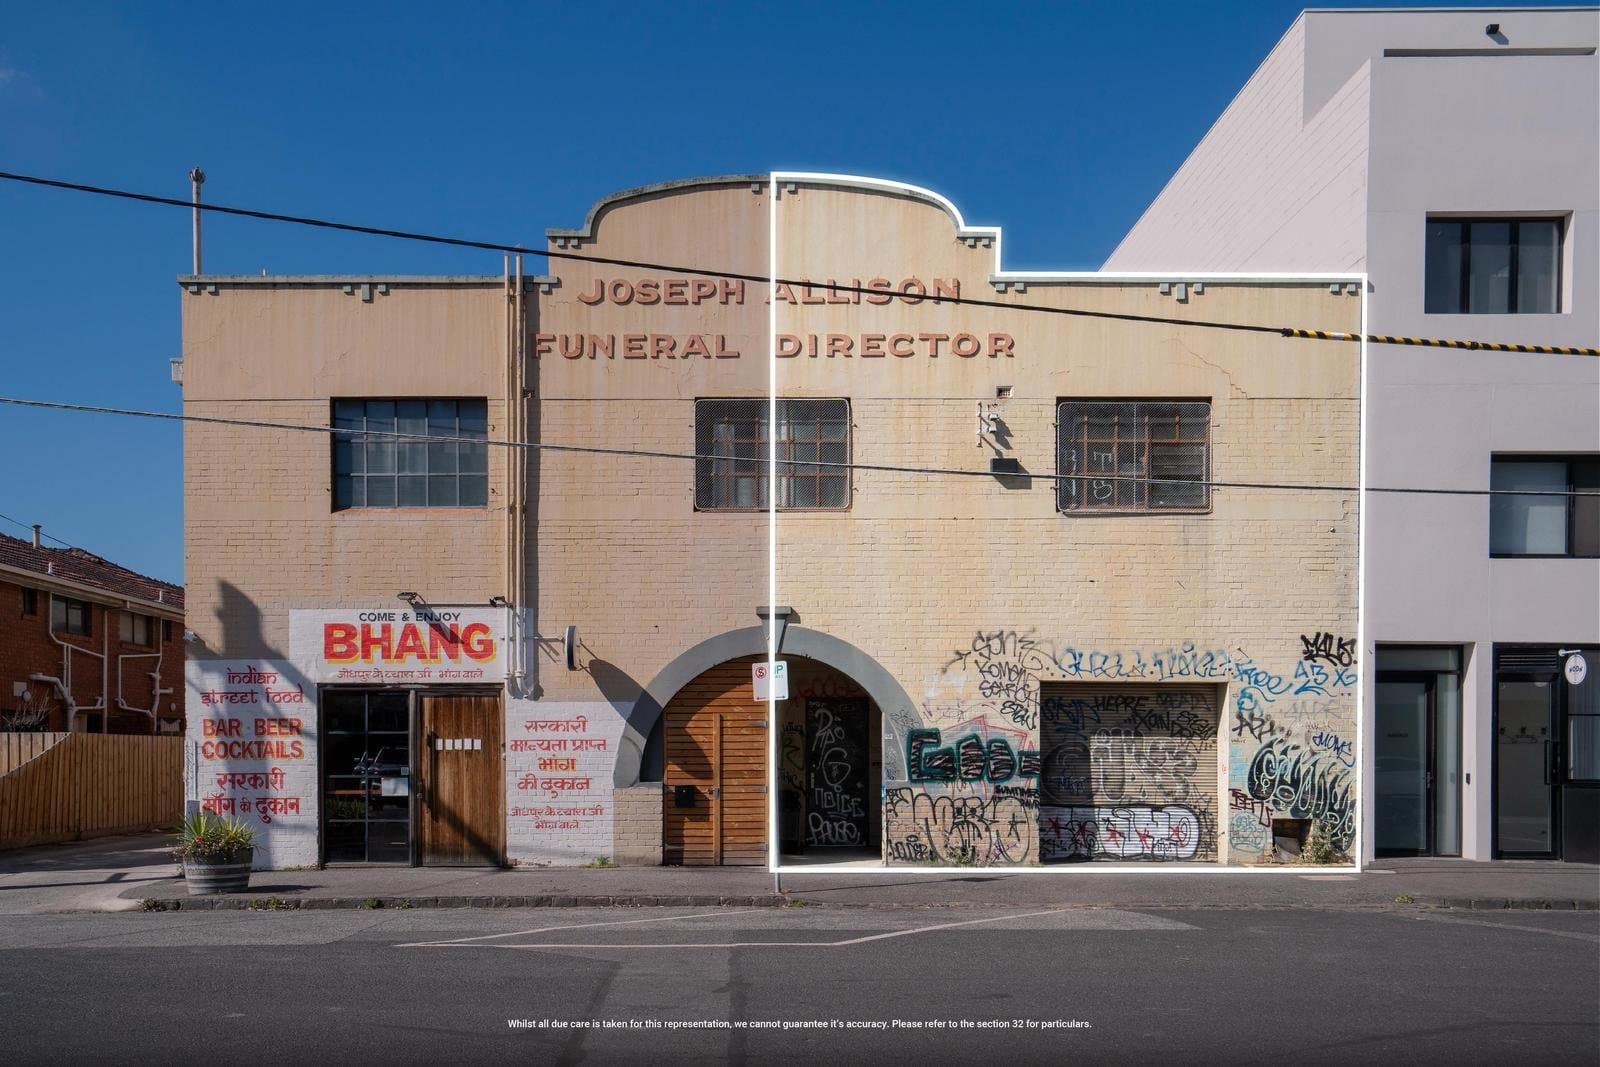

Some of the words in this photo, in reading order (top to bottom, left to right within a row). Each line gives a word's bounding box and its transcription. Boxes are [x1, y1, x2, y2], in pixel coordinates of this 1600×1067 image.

[577, 278, 744, 305] JOSEPH
[768, 277, 961, 305] ALLISON
[532, 333, 741, 360] FUNERAL
[775, 332, 1016, 359] DIRECTOR
[359, 612, 396, 622] COME
[401, 612, 410, 622] &
[415, 612, 461, 622] ENJOY
[324, 622, 497, 665] BHANG
[227, 665, 278, 684] indian
[200, 689, 258, 706] street
[265, 683, 304, 703] food
[203, 718, 241, 737] BAR
[254, 718, 303, 737] BEER
[525, 715, 588, 732] सरकारी
[202, 741, 304, 760] COCKTAILS
[216, 767, 286, 791] सरकारी
[256, 798, 300, 824] दुकान
